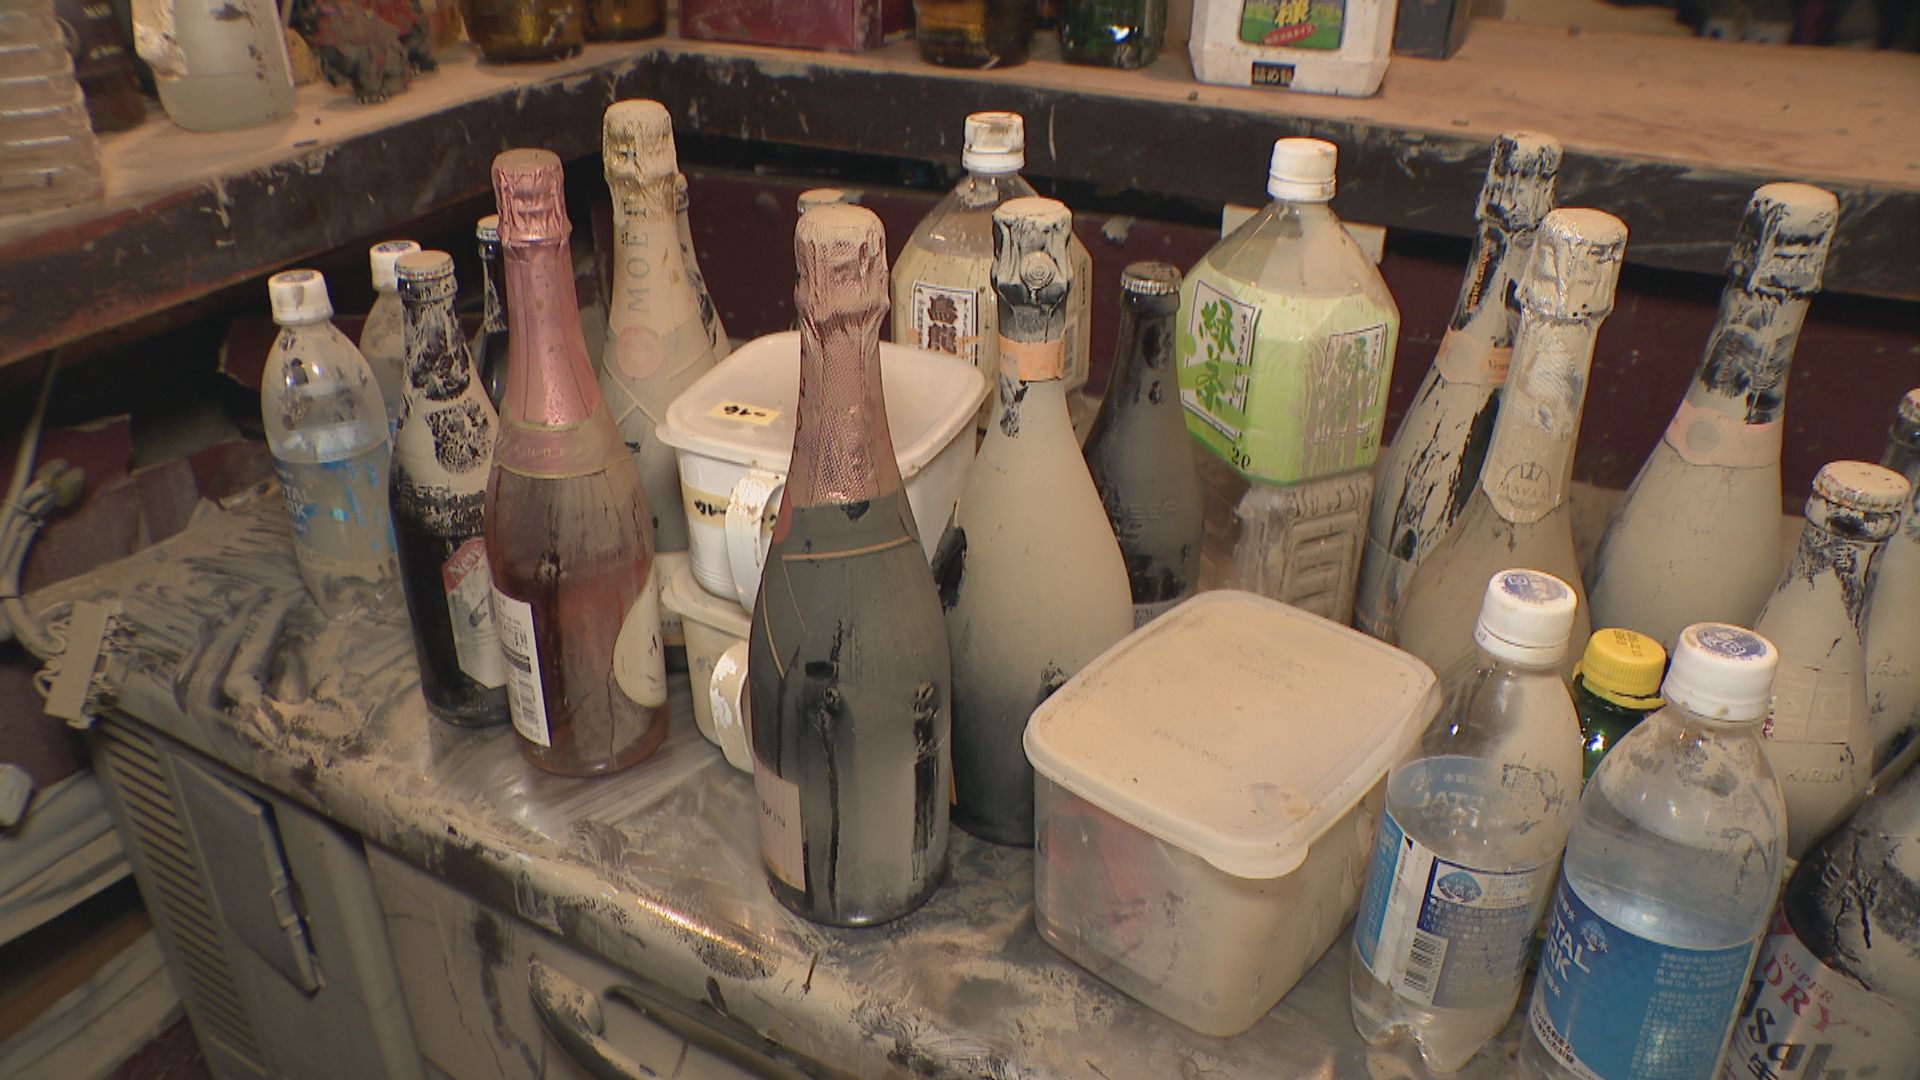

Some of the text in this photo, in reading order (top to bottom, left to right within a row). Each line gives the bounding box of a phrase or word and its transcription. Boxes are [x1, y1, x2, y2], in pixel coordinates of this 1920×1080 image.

[620, 201, 650, 314] MOËT
[1195, 298, 1236, 413] 緑茶
[1785, 767, 1844, 782] KIRIN
[1782, 953, 1834, 1003] SUPER
